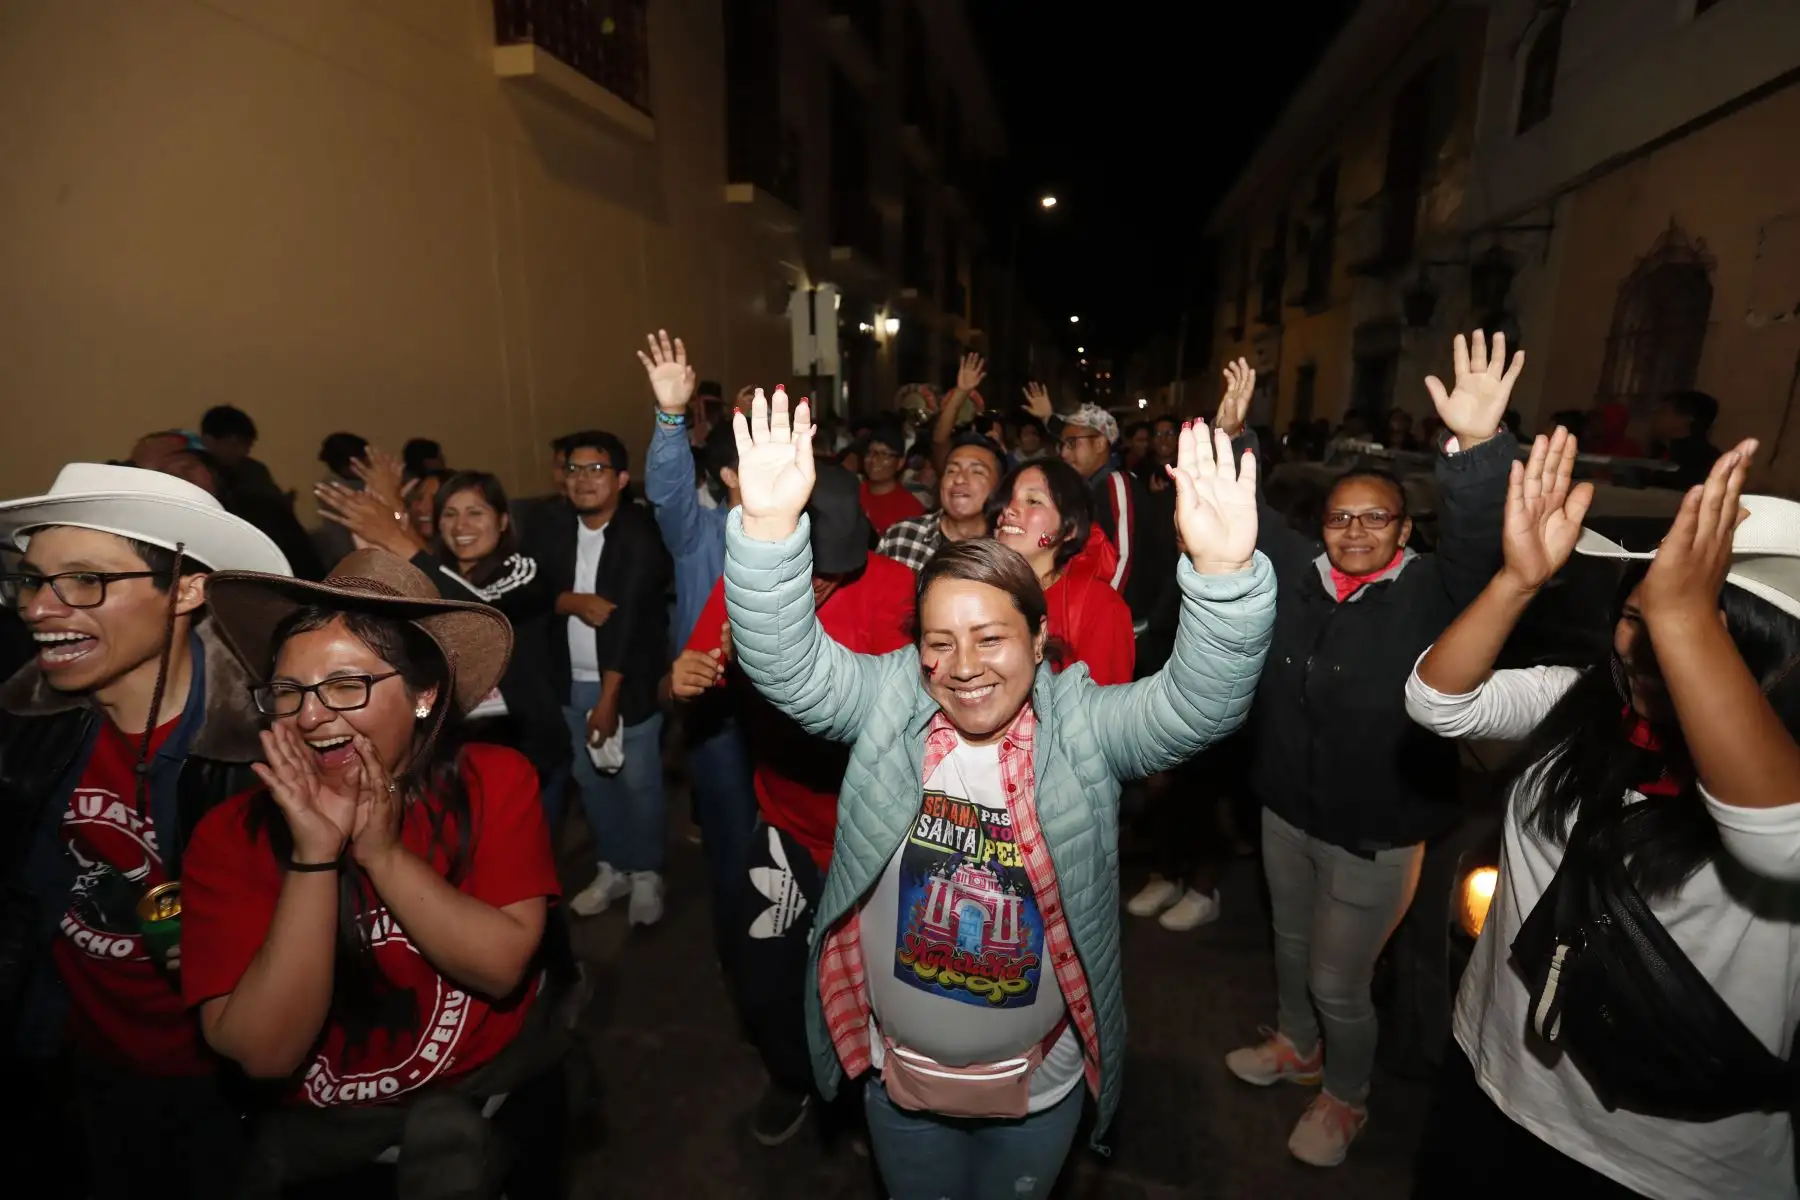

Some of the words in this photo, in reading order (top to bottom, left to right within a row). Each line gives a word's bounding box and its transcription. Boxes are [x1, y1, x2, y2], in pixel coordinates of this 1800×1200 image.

[916, 813, 976, 855] SANTA
[59, 912, 135, 958] UCHO
[418, 990, 465, 1062] PERU
